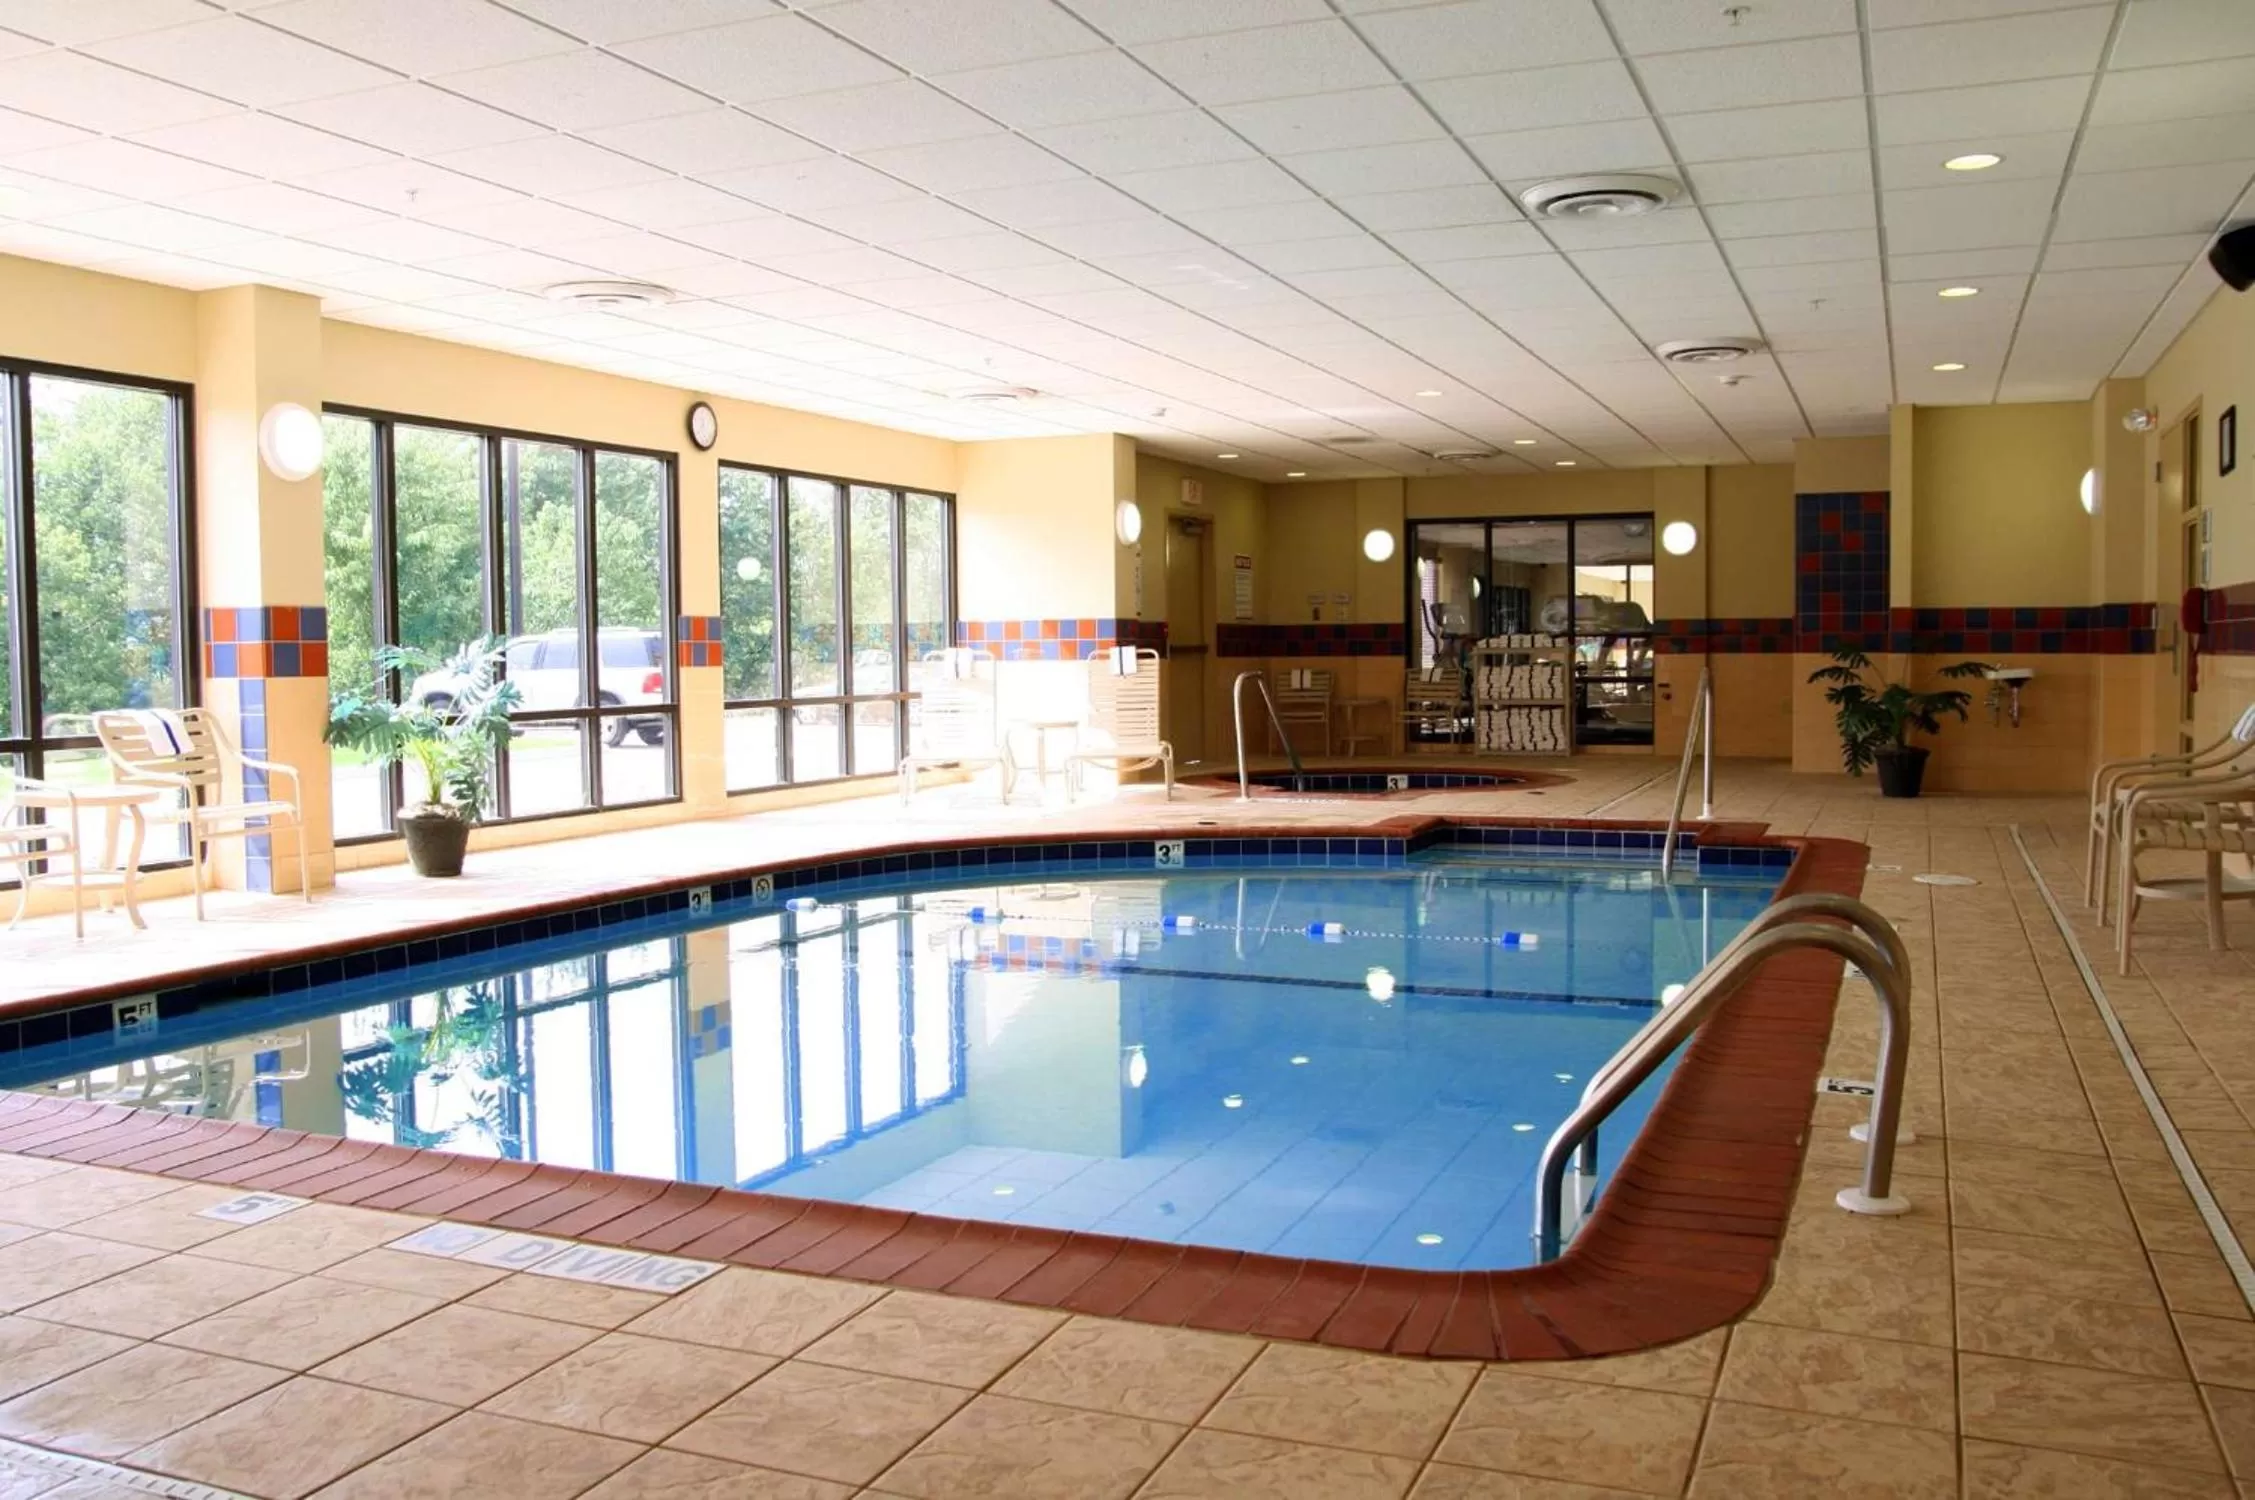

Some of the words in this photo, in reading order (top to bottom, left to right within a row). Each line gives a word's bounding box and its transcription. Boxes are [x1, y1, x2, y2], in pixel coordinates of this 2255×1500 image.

[1159, 844, 1171, 865] 3
[118, 1004, 141, 1027] 5
[139, 1001, 153, 1016] FT
[214, 1195, 276, 1214] 5
[496, 1240, 709, 1287] DIVING
